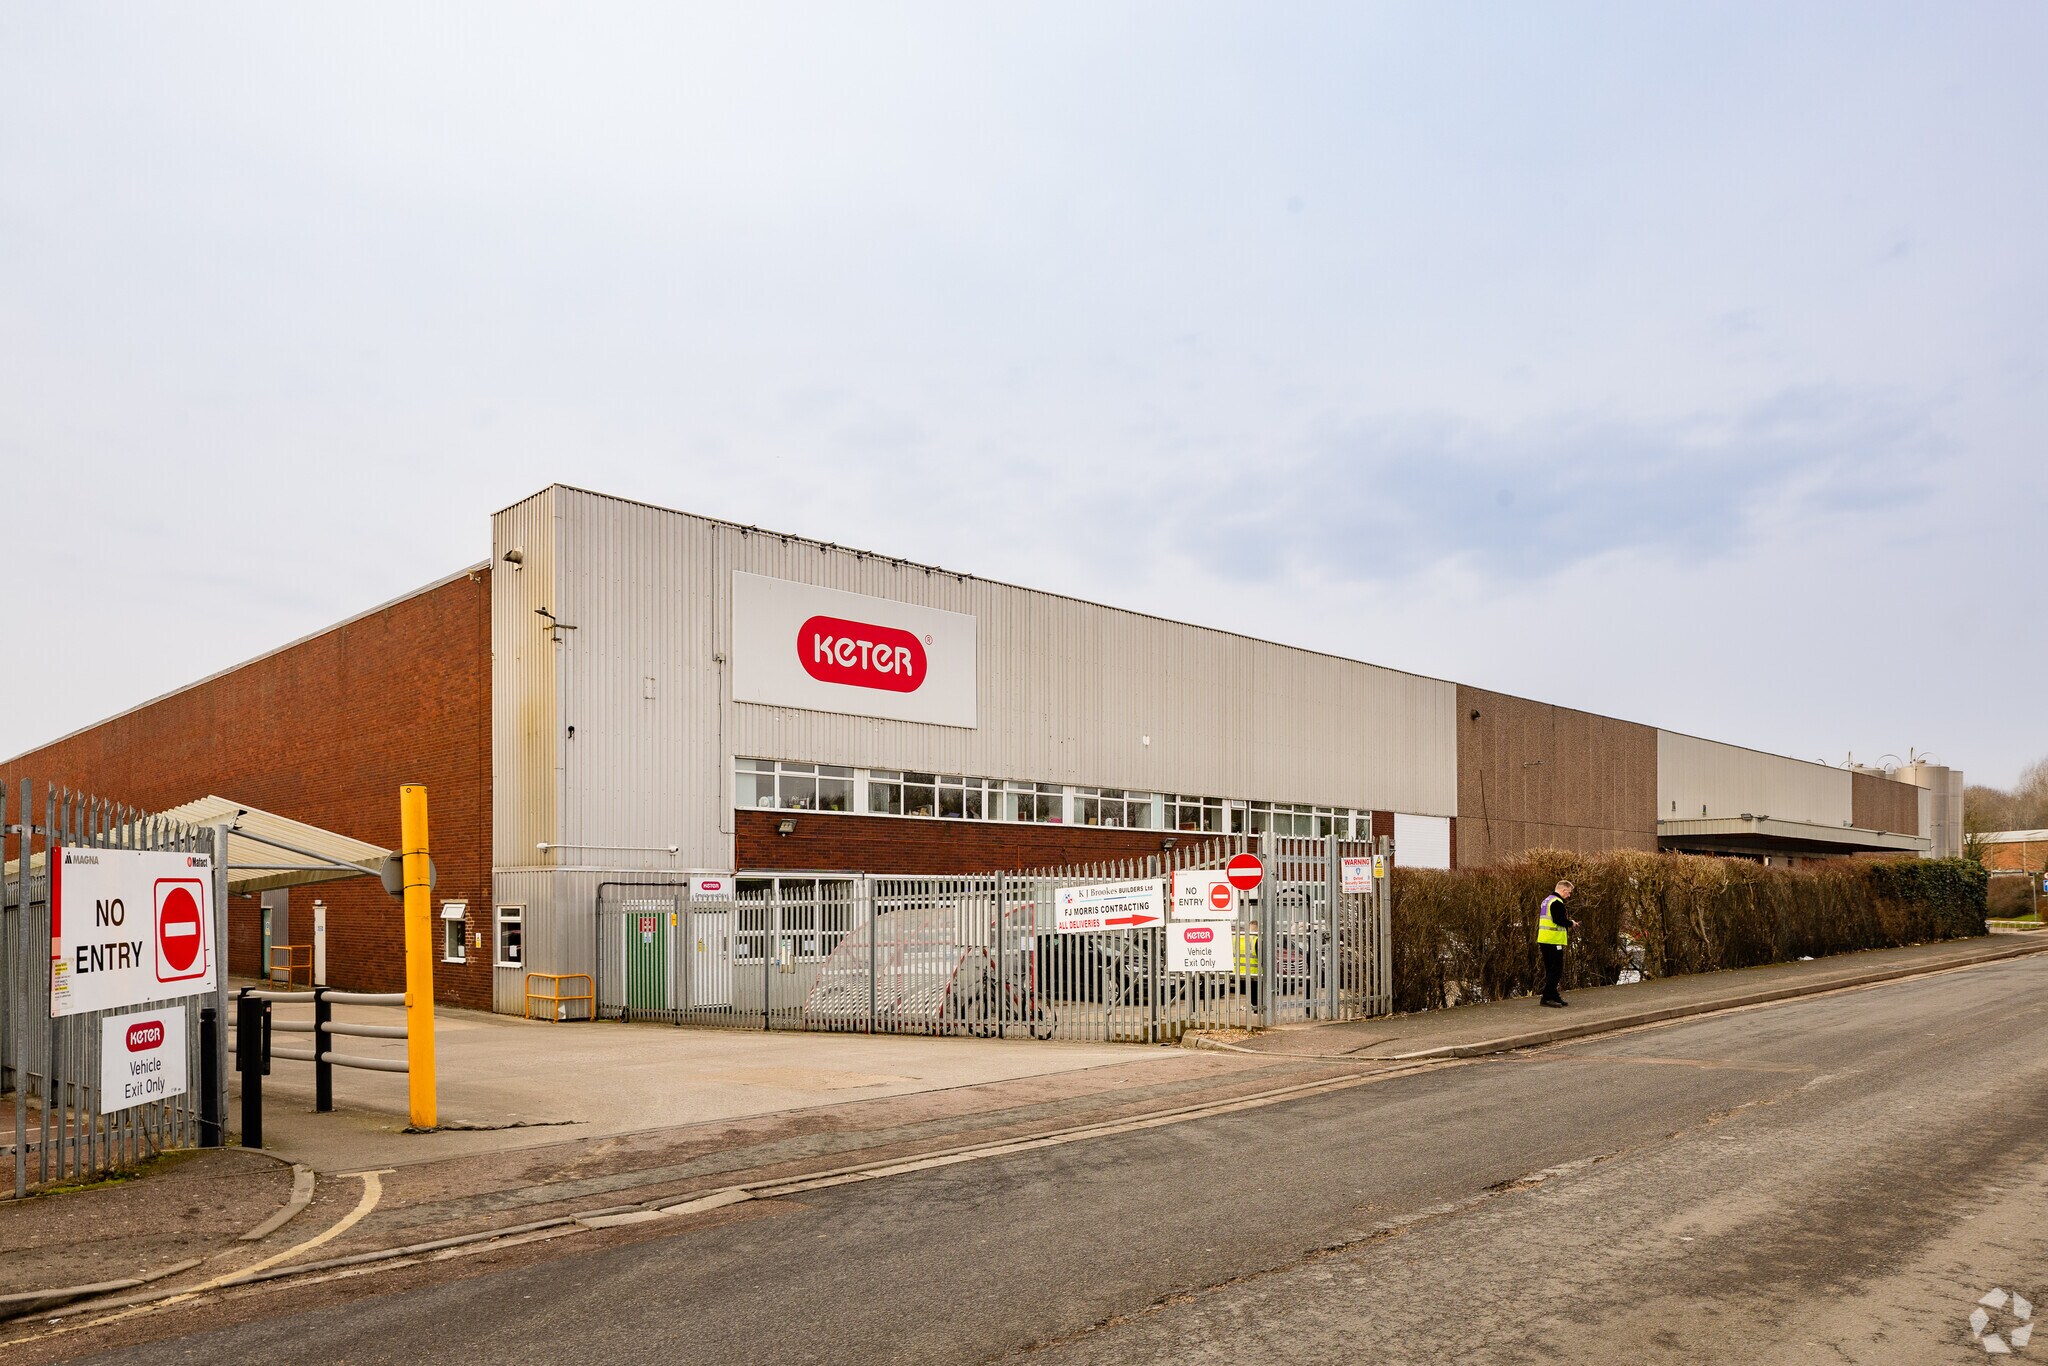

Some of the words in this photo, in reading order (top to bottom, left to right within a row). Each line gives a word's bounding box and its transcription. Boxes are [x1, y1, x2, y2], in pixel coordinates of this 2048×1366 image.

[73, 854, 99, 865] MAGNA
[1078, 890, 1084, 898] K
[1091, 887, 1117, 896] Brookes
[1118, 886, 1143, 894] BUILDERS
[1185, 887, 1197, 895] NO
[1179, 898, 1204, 906] ENTRY
[96, 898, 124, 927] NO
[1074, 906, 1099, 915] MORRIS
[1100, 902, 1149, 913] CONTRACTING
[1059, 921, 1068, 930] ALL
[1069, 919, 1100, 929] DELIVERIES
[76, 941, 143, 974] ENTRY
[1187, 948, 1212, 956] Vehicle
[1184, 958, 1198, 967] Exit
[1200, 958, 1216, 968] Only
[130, 1057, 161, 1076] Vehicle
[125, 1081, 143, 1099] Exit
[146, 1077, 165, 1094] Only
